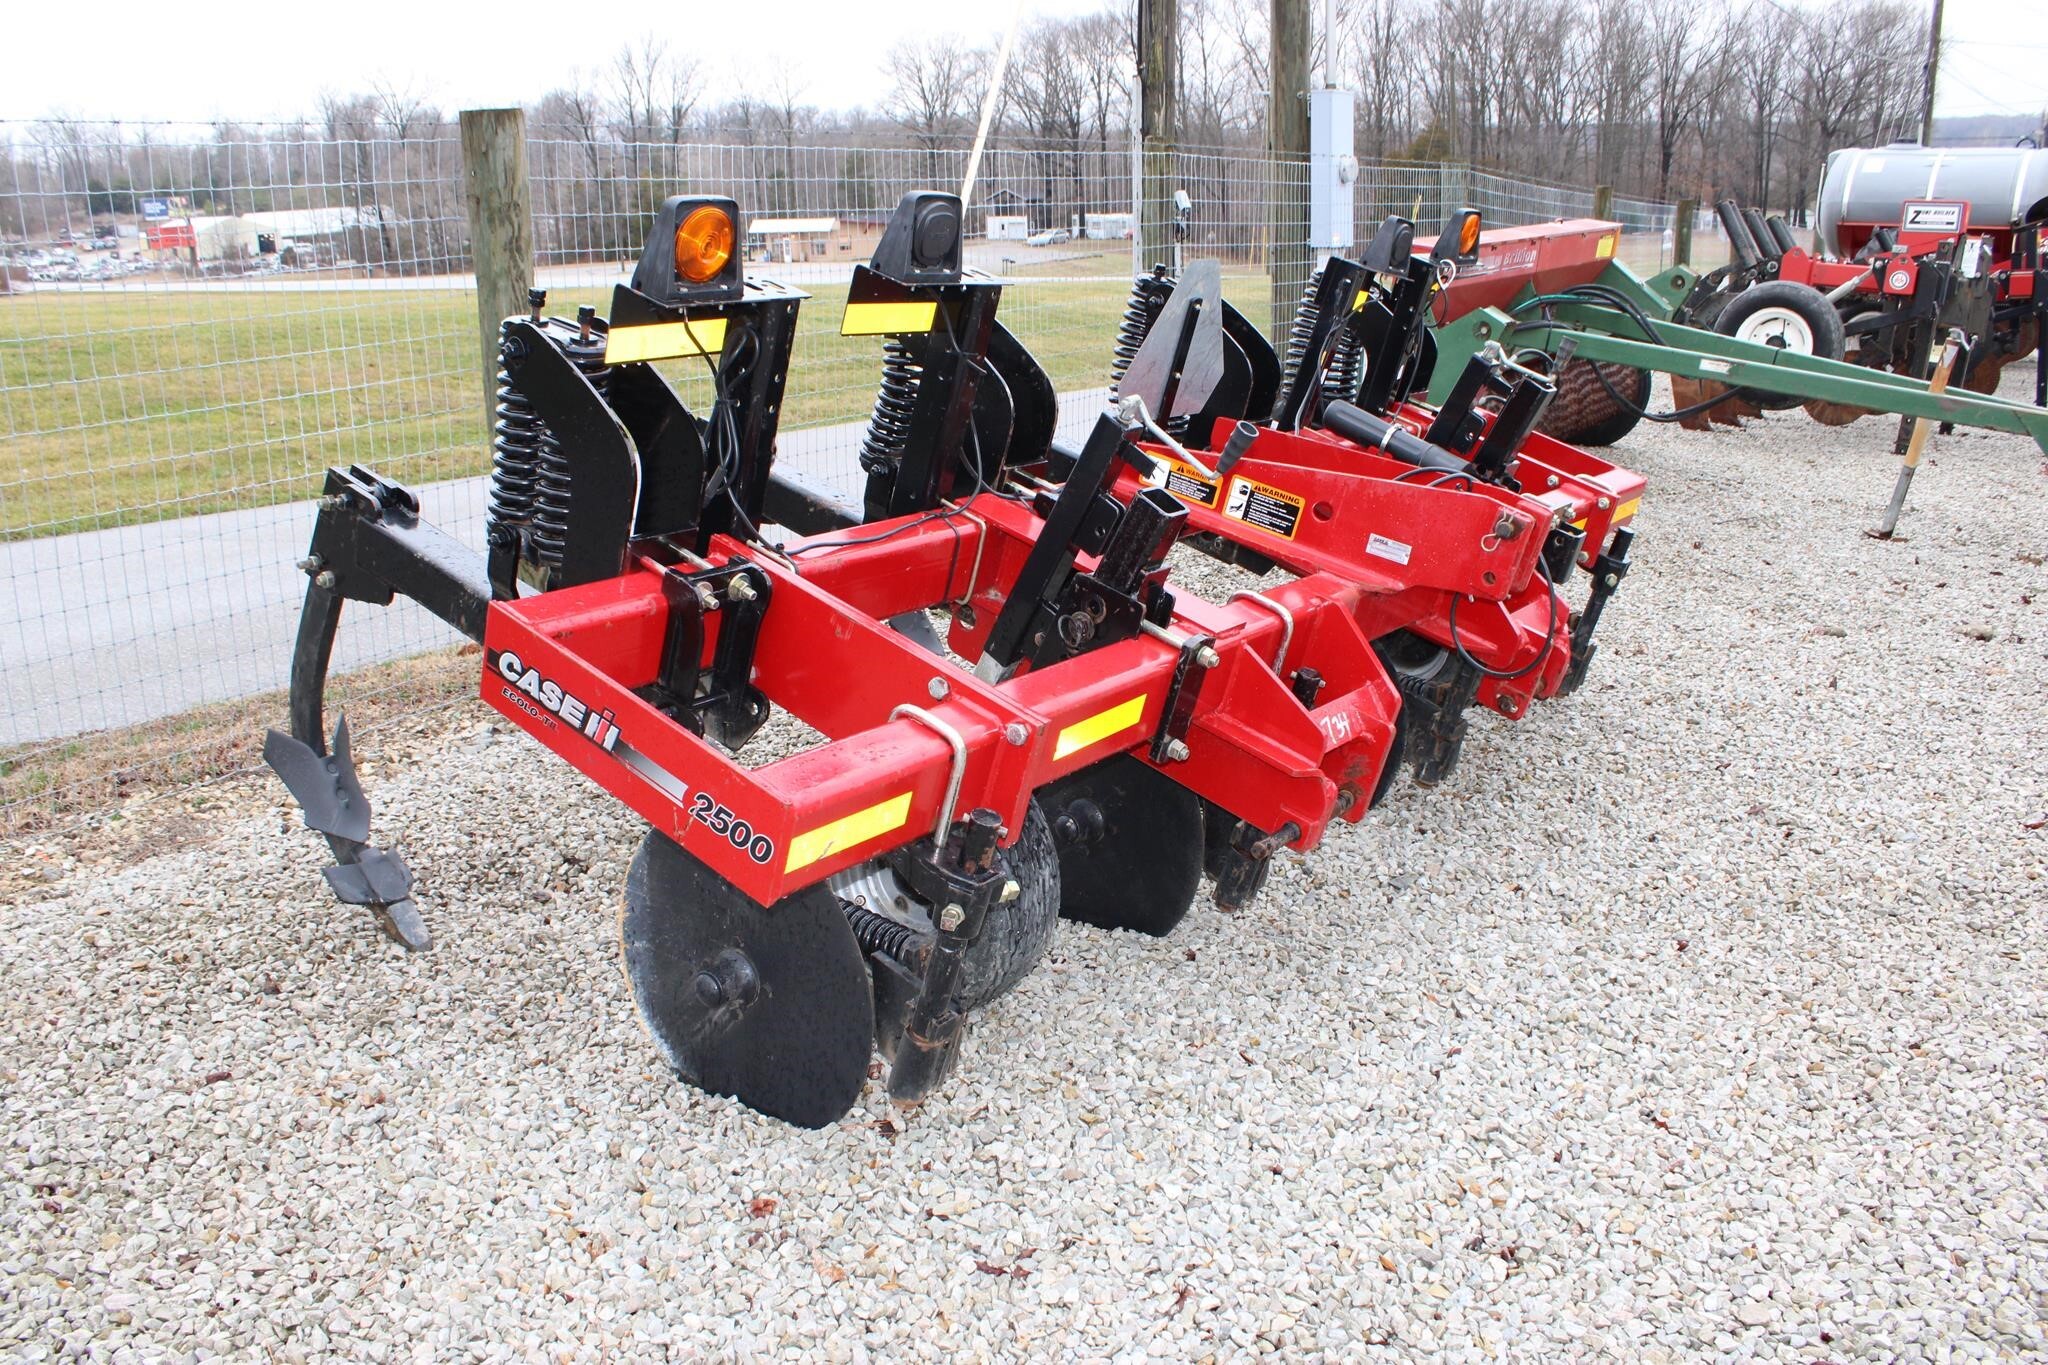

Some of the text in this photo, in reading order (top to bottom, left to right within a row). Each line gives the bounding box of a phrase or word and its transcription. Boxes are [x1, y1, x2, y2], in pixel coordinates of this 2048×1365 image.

[1262, 486, 1300, 505] WARNING
[499, 652, 588, 729] CASE
[1320, 711, 1352, 745] 734
[688, 792, 774, 864] 2500
